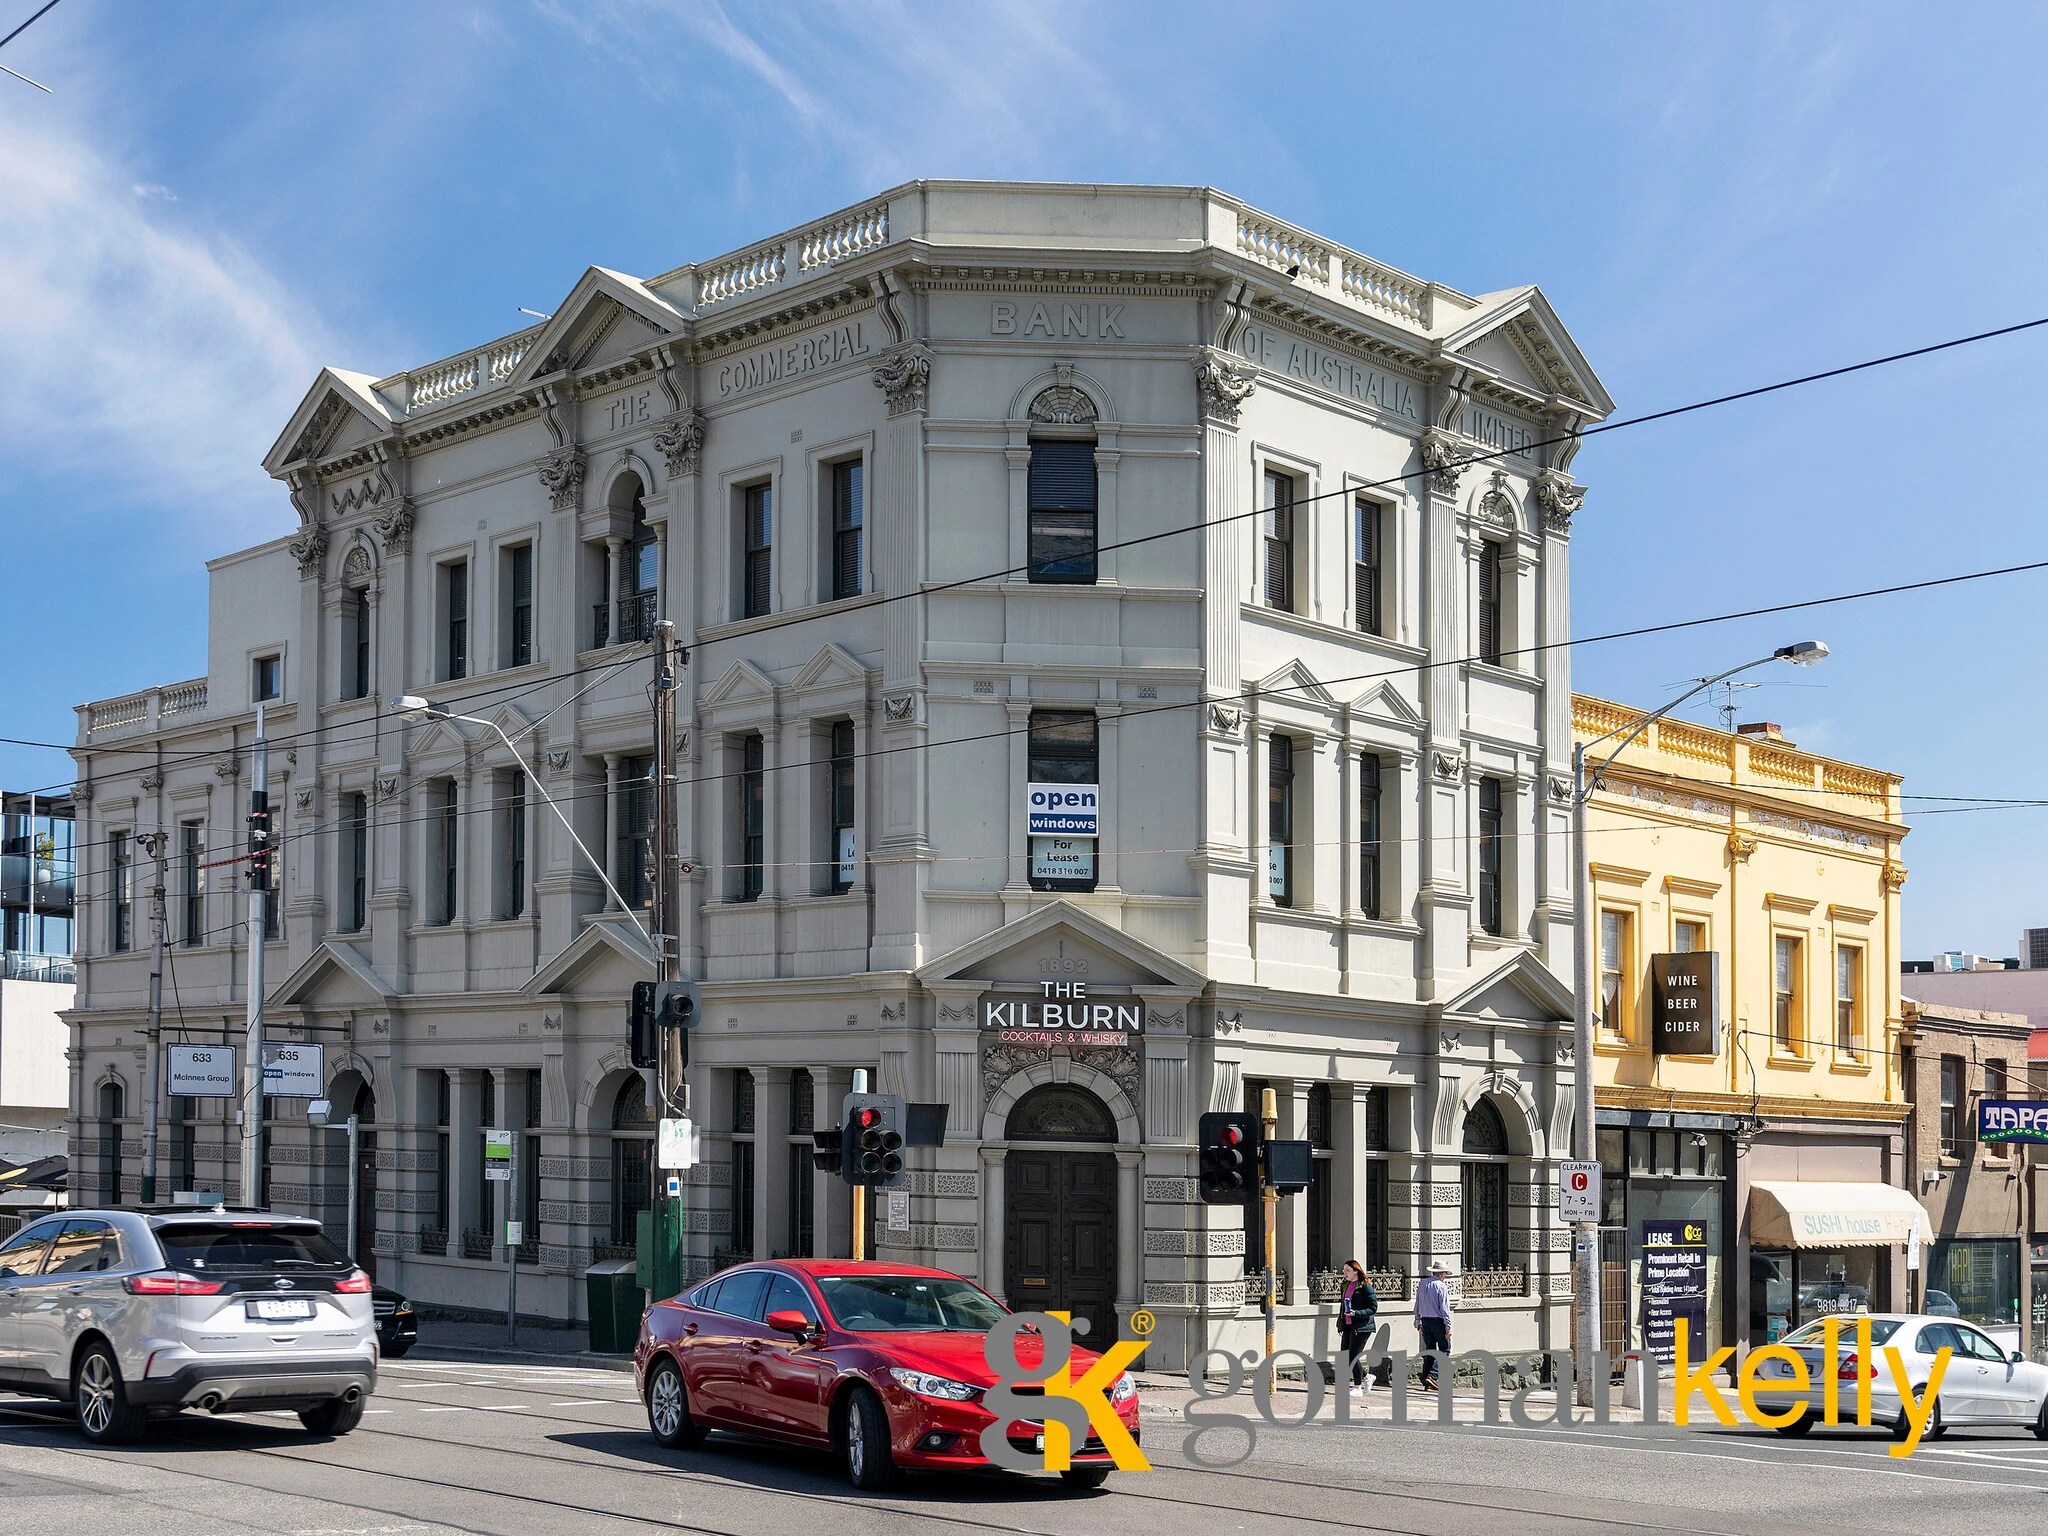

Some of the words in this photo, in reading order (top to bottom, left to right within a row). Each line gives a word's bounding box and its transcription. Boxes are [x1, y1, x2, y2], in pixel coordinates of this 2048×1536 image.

[991, 301, 1126, 338] BANK
[604, 390, 650, 431] THE
[718, 322, 869, 397] COMMERCIAL
[1242, 326, 1277, 365] OF
[1287, 343, 1416, 420] AUSTRALIA
[1031, 791, 1096, 811] open
[1031, 817, 1096, 829] windows
[1053, 839, 1073, 849] For
[1047, 852, 1080, 862] Lease
[1037, 867, 1057, 875] 0418
[1058, 867, 1073, 875] 310
[1073, 868, 1089, 876] 007
[1037, 957, 1089, 974] 1892
[1667, 975, 1698, 987] WINE
[1040, 981, 1086, 999] THE
[1667, 998, 1698, 1009] BEER
[985, 1002, 1140, 1030] KILBURN
[1665, 1021, 1700, 1032] CIDER
[1001, 1030, 1063, 1042] COCKTAILS
[1067, 1031, 1076, 1043] &
[1081, 1033, 1125, 1044] WHISKY
[192, 1053, 212, 1063] 633
[278, 1050, 299, 1061] 635
[174, 1073, 206, 1082] McInnes
[207, 1074, 230, 1083] Group
[264, 1070, 282, 1079] open
[284, 1070, 315, 1078] windows
[1562, 1163, 1598, 1171] CLEARWAY
[1575, 1174, 1584, 1190] C
[1804, 1214, 1842, 1235] SUSHI
[1845, 1215, 1882, 1234] house
[1647, 1232, 1673, 1245] LEASE
[1647, 1253, 1677, 1264] Prominent
[1677, 1252, 1694, 1264] Retail
[1647, 1267, 1665, 1278] Prime
[1665, 1266, 1690, 1278] Location
[1817, 1298, 1837, 1313] 9819
